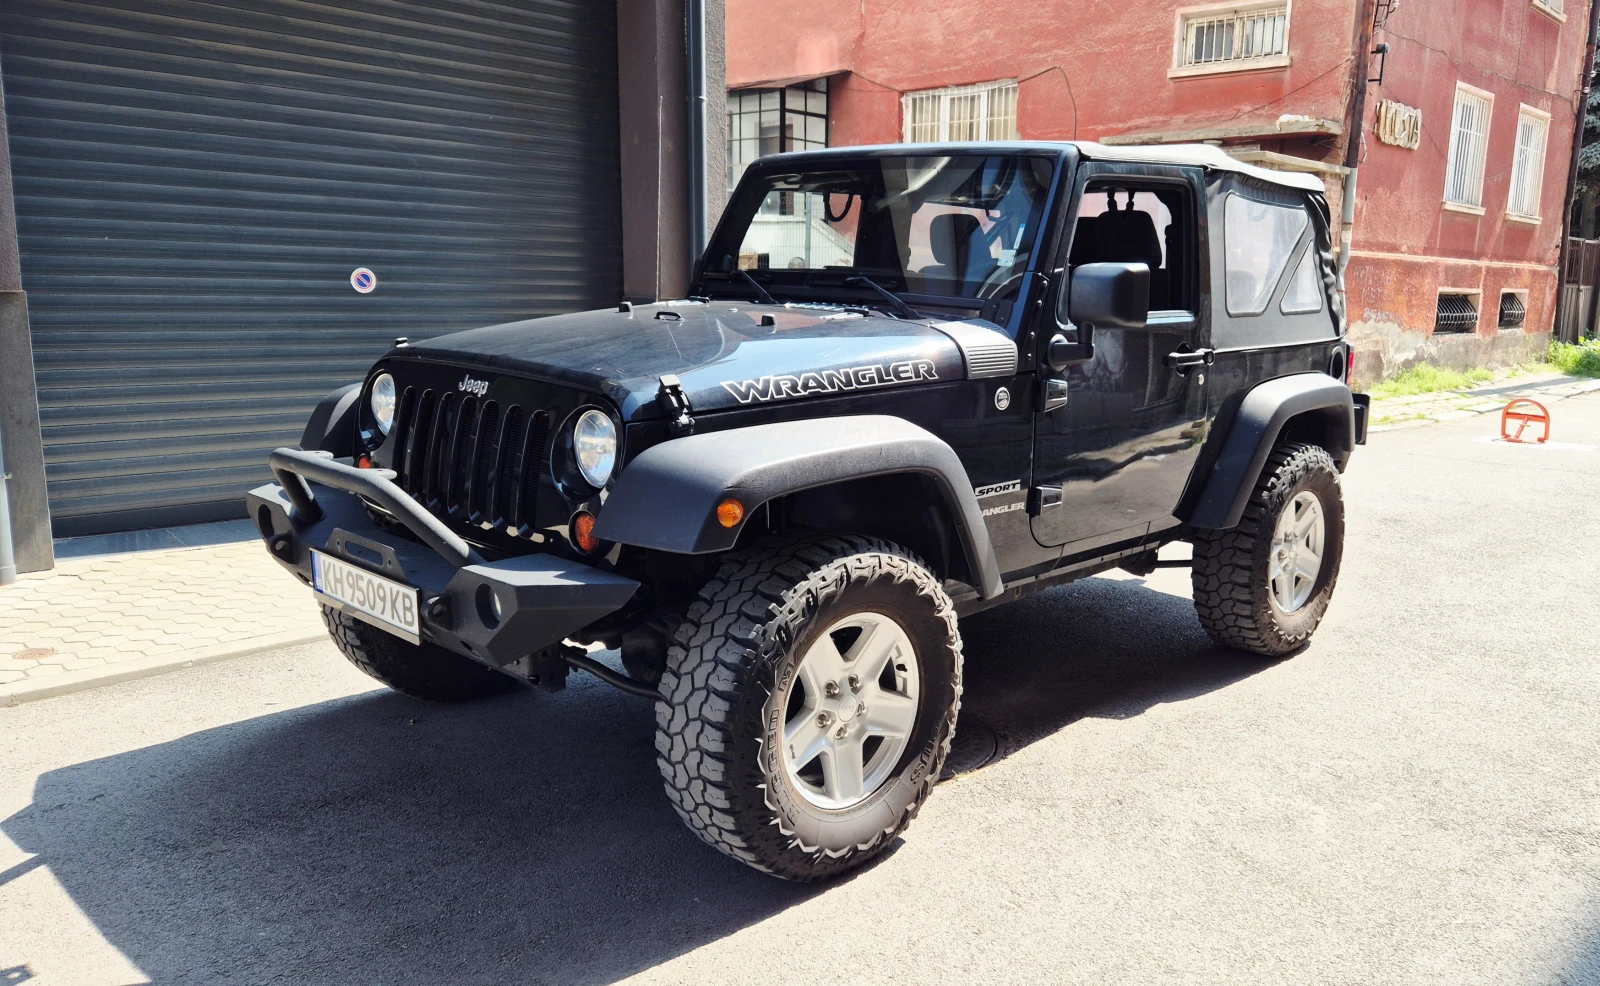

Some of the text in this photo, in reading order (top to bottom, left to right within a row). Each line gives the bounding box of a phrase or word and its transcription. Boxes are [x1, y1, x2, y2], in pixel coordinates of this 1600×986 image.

[458, 374, 489, 398] Jeep
[720, 359, 939, 404] WRANGLER
[975, 482, 1021, 497] SPORT
[982, 502, 1025, 517] ANGLER
